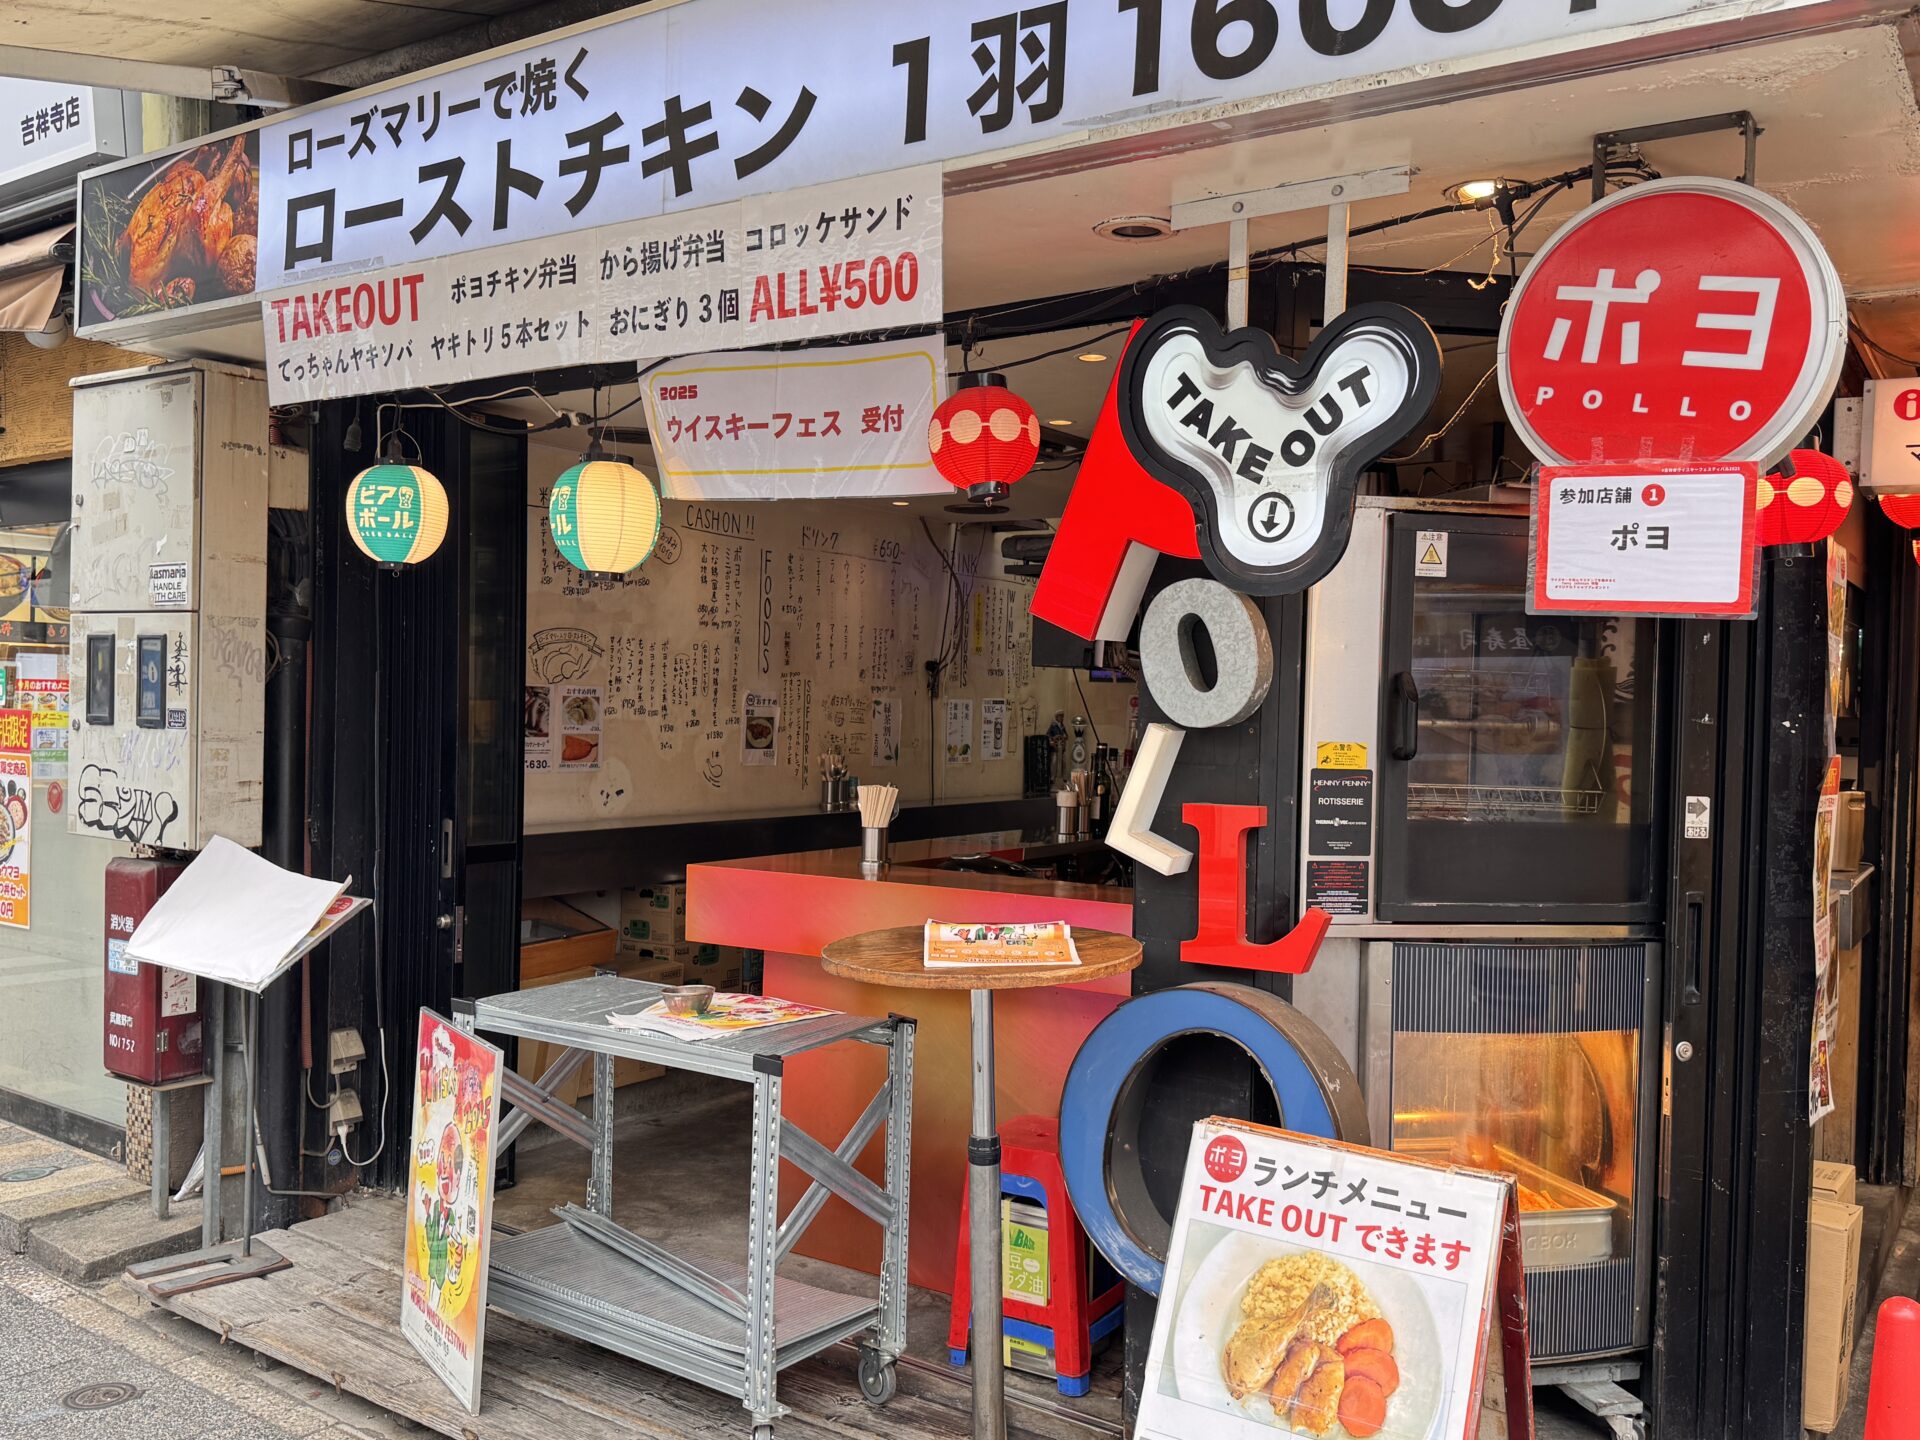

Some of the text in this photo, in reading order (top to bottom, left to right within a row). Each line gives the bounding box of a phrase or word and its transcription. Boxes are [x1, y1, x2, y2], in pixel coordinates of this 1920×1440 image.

[20, 96, 81, 147] 吉祥寺店
[288, 48, 590, 174] ローズマリーで焼く
[284, 85, 818, 271] ローストチキン
[270, 195, 914, 344] TAKEOUT ポヨチキン弁当 から揚げ弁当 コロッケサンド
[278, 250, 920, 383] てっちゃんヤキソバ ヤキトリ5本セット おにぎり3個 ALL¥500
[1542, 268, 1781, 372] ポヨ
[660, 384, 699, 401] 2025
[1536, 386, 1752, 422] POLLO
[667, 404, 904, 443] ウイスキーフェス 受付
[1166, 365, 1374, 486] TAKE OUT
[360, 485, 397, 505] ビア
[1559, 487, 1633, 504] 参加店舗
[359, 508, 414, 530] ボール
[801, 525, 839, 550] ドリンク
[1429, 533, 1443, 542] 注意
[1610, 522, 1670, 551] ポヨ
[153, 581, 182, 592] HANDLE
[167, 591, 186, 600] CARE
[762, 549, 773, 675] FOODS
[883, 703, 892, 752] 緑茶割り
[1339, 744, 1352, 752] 警告
[1313, 779, 1340, 787] HENNY
[1318, 797, 1364, 806] ROTISSERIE
[1687, 827, 1707, 837] あける
[110, 914, 134, 933] 消火器
[164, 991, 169, 1000] 3
[1208, 1145, 1244, 1168] ポヨ
[1207, 1164, 1240, 1175] POLLO
[1253, 1156, 1469, 1221] ランチメニュー
[1199, 1185, 1472, 1273] TAKE OUT できます
[410, 1286, 426, 1316] WORLD
[426, 1303, 445, 1336] WHISKY
[445, 1324, 468, 1362] FESTIVAL
